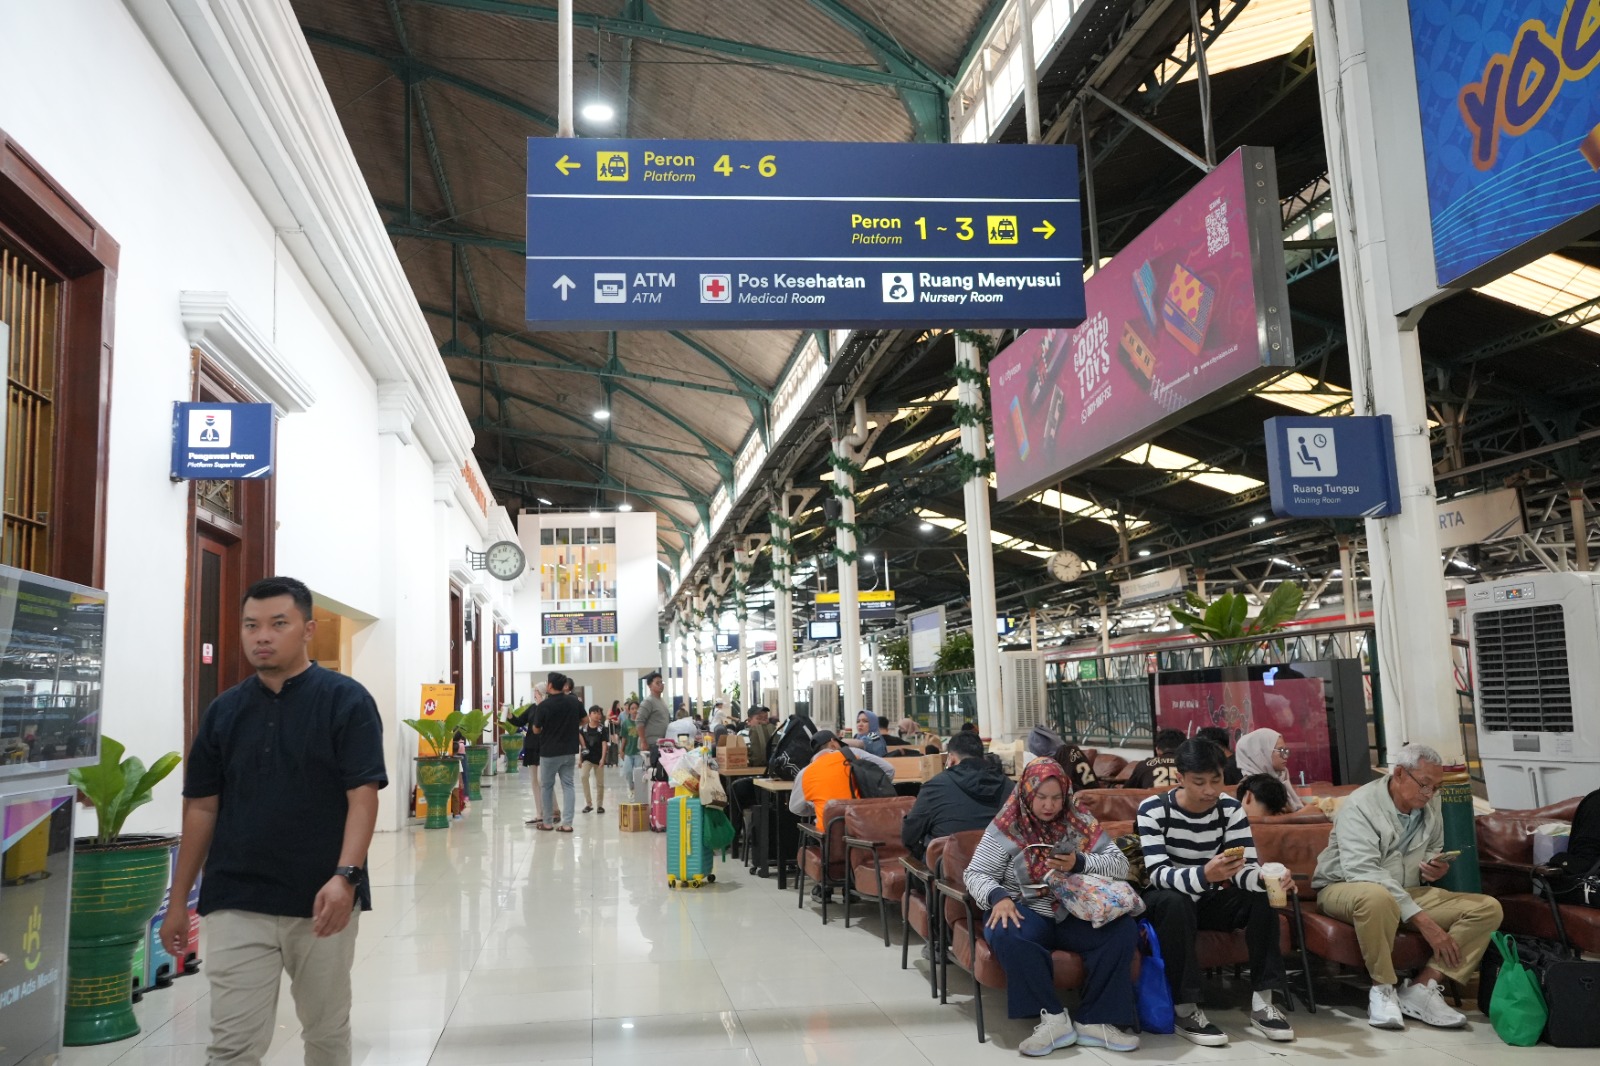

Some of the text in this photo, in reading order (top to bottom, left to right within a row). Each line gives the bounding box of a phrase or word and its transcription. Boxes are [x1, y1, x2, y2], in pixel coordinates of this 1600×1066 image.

[643, 151, 695, 168] Peron
[713, 154, 734, 177] 4
[758, 154, 777, 178] 6
[643, 169, 696, 182] Platform
[851, 213, 901, 229] Peron
[914, 216, 927, 240] 1
[955, 217, 975, 241] 3
[851, 231, 903, 245] Platform
[633, 272, 675, 288] ATM
[739, 273, 866, 289] Pos Kesehatan
[920, 271, 1062, 290] Ruang Menyusui
[632, 292, 662, 304] ATM
[738, 292, 826, 304] Medical Room
[920, 291, 1004, 305] Nursery Room
[230, 452, 255, 460] Peron
[214, 461, 246, 469] Supervisor
[1292, 483, 1360, 495] Ruang Tunggu
[1294, 496, 1341, 505] Waiting Room
